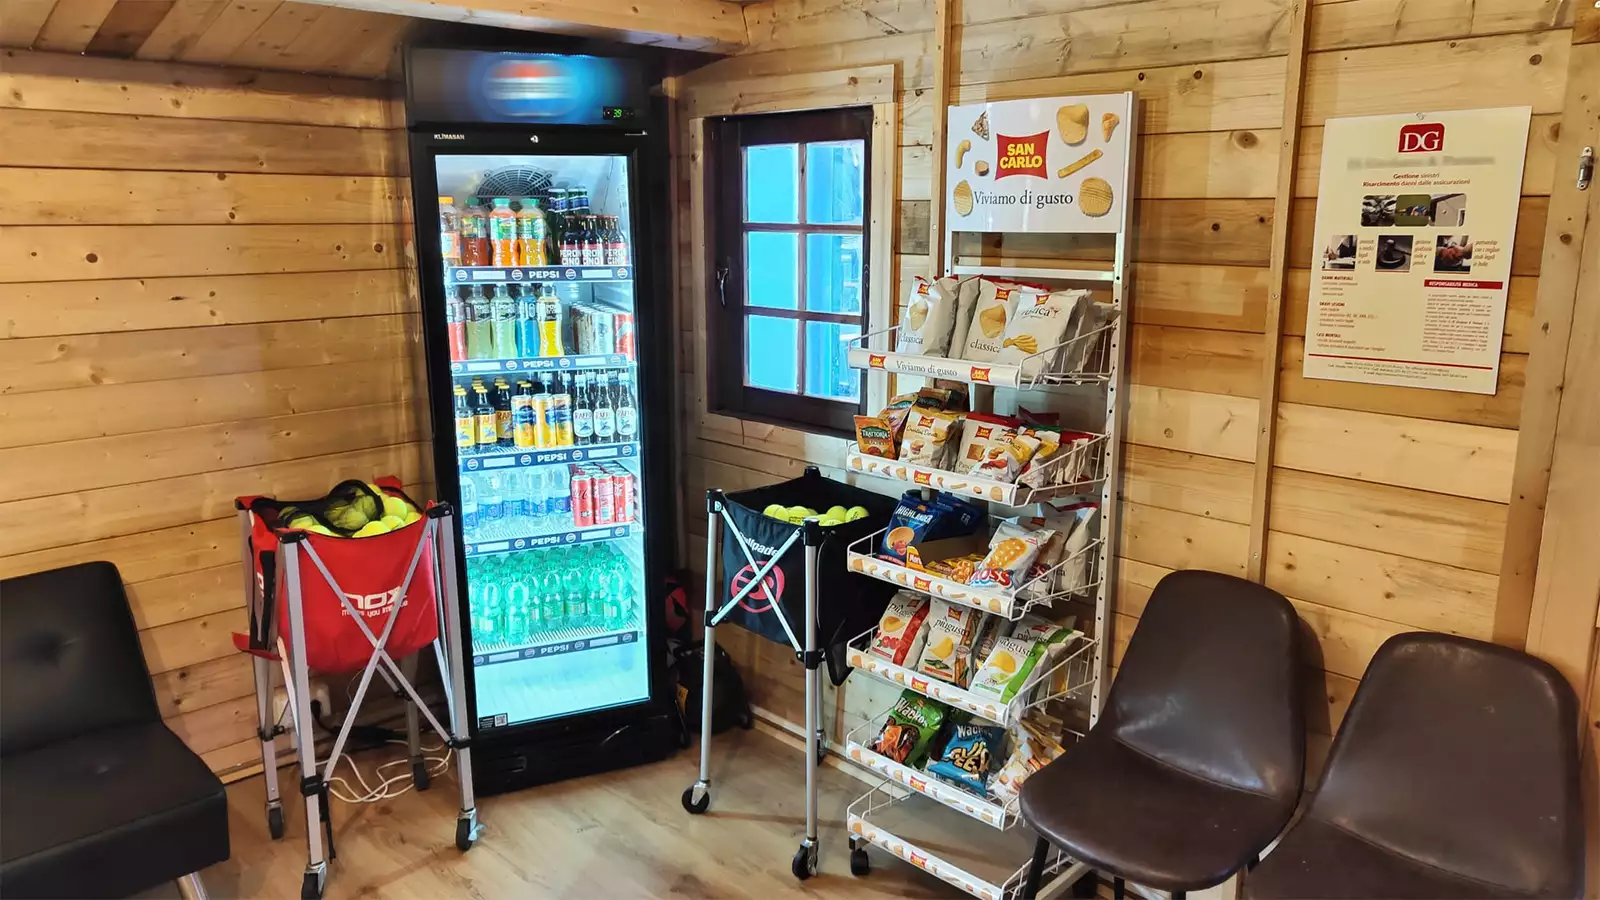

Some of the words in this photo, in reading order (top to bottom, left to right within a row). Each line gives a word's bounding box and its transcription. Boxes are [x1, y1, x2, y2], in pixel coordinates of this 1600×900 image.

[1401, 131, 1440, 151] DG
[1007, 143, 1035, 156] SAN
[1000, 155, 1043, 169] CARLO
[974, 191, 1016, 205] Viviamo
[1020, 190, 1032, 204] di
[1036, 193, 1074, 209] gusto
[529, 270, 559, 279] PEPSI
[523, 360, 553, 369] PEPSI
[896, 360, 926, 372] Viviamo
[928, 364, 936, 373] di
[937, 366, 958, 376] gusto
[862, 430, 888, 438] TRATTORIA
[538, 453, 567, 462] PEPSI
[896, 505, 933, 524] HIGHLANDER
[531, 537, 560, 546] PEPSI
[367, 609, 380, 618] you
[541, 644, 569, 654] PEPSI
